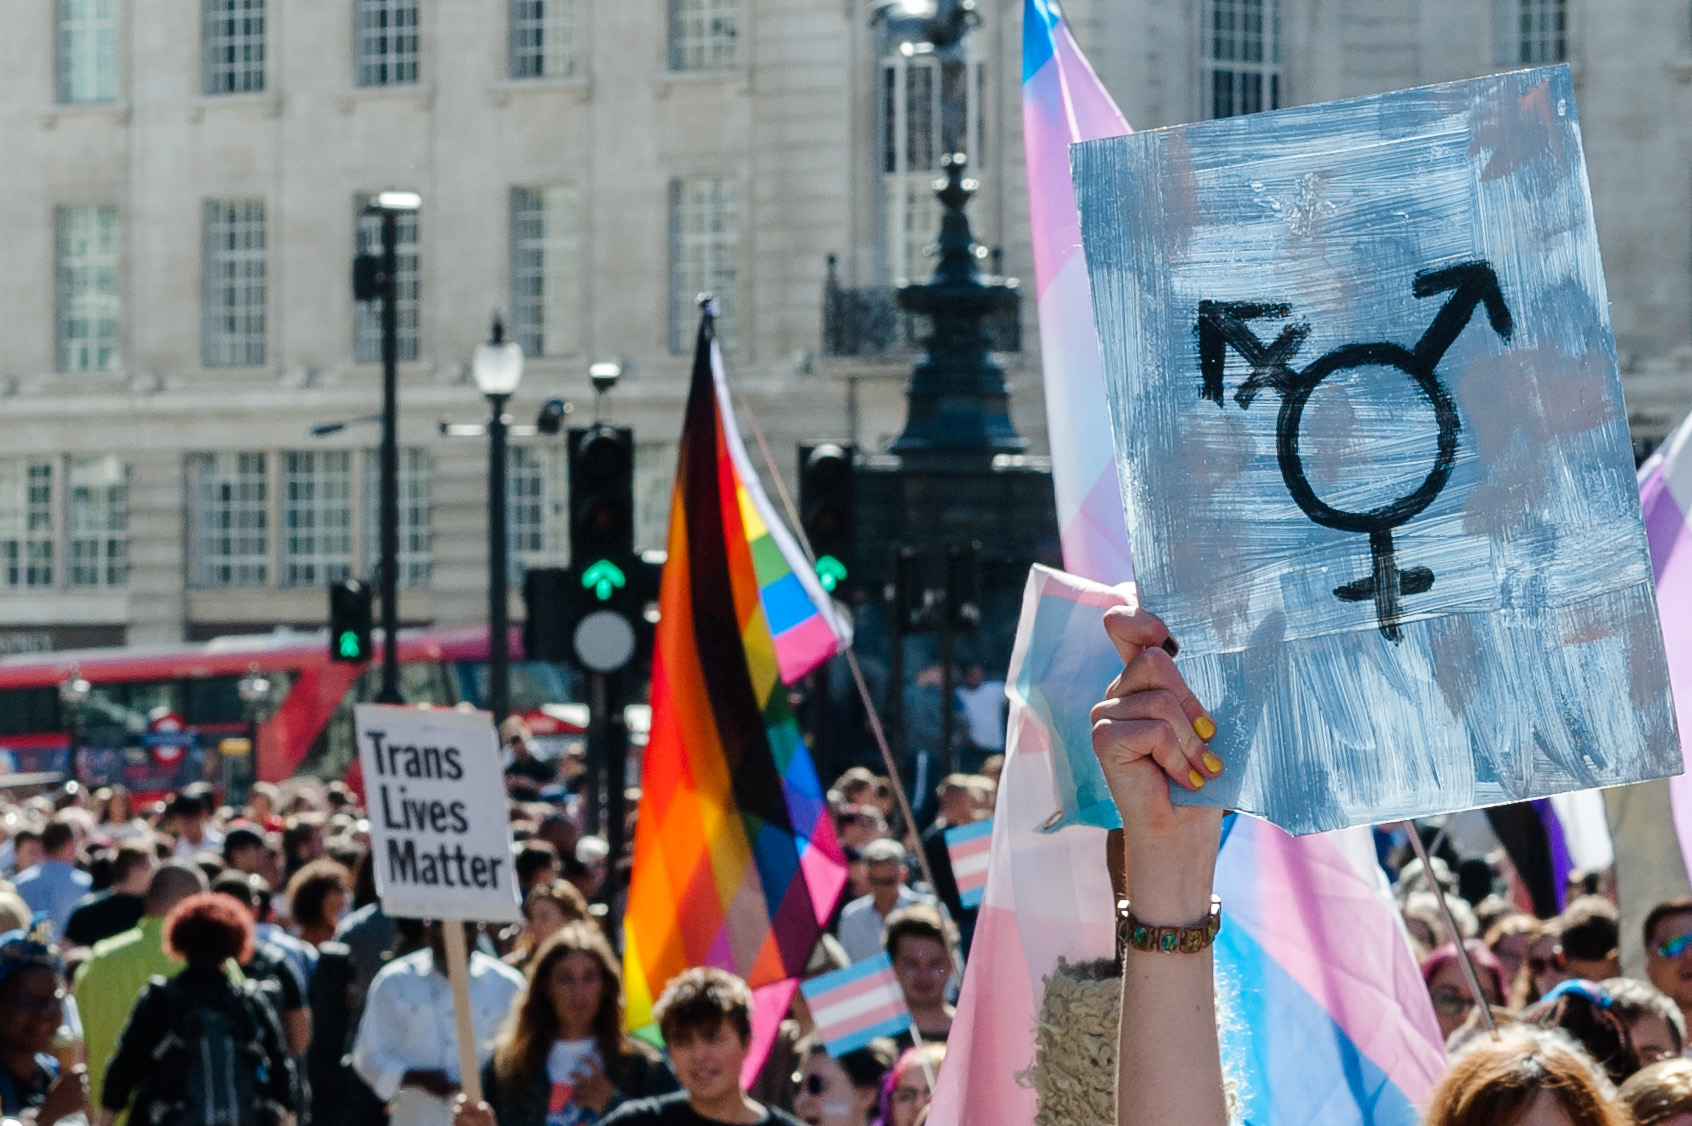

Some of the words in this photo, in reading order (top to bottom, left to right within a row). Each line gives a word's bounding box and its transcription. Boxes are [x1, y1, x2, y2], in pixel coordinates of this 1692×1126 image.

[367, 730, 464, 780] Trans
[380, 785, 469, 834] Lives
[387, 838, 503, 889] Matter
